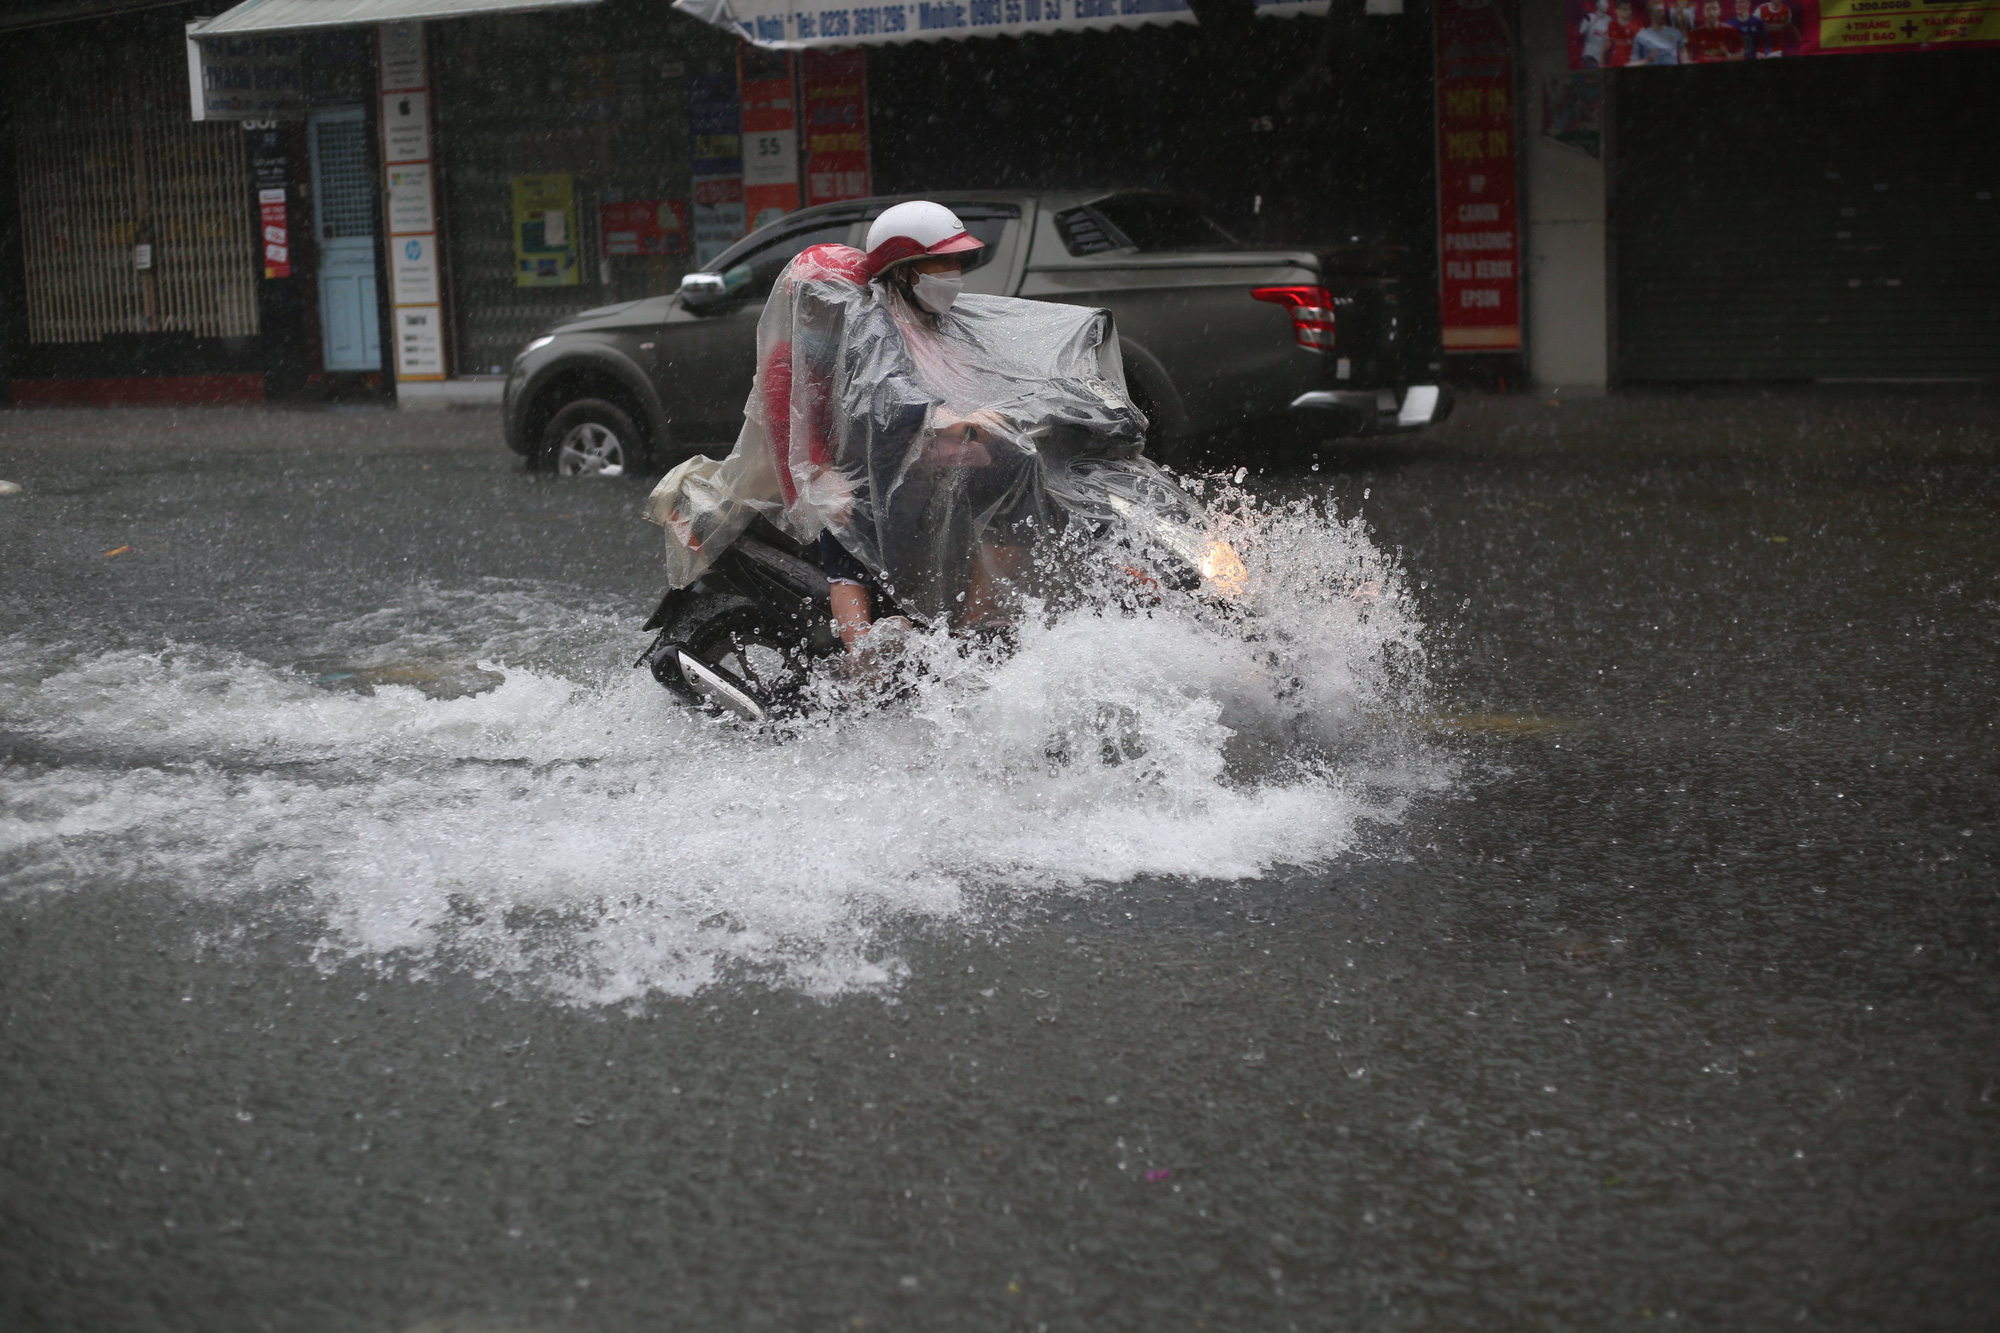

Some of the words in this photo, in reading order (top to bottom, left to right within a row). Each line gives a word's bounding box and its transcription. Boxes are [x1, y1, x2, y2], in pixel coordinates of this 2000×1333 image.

[1873, 32, 1896, 41] BAO
[758, 138, 781, 156] 55
[1457, 203, 1500, 223] CANON
[1445, 231, 1513, 251] PANASONIC
[828, 267, 856, 277] HONDA
[1446, 260, 1472, 280] FUJI
[1474, 260, 1513, 280] XEROX
[1460, 288, 1501, 309] EPSON
